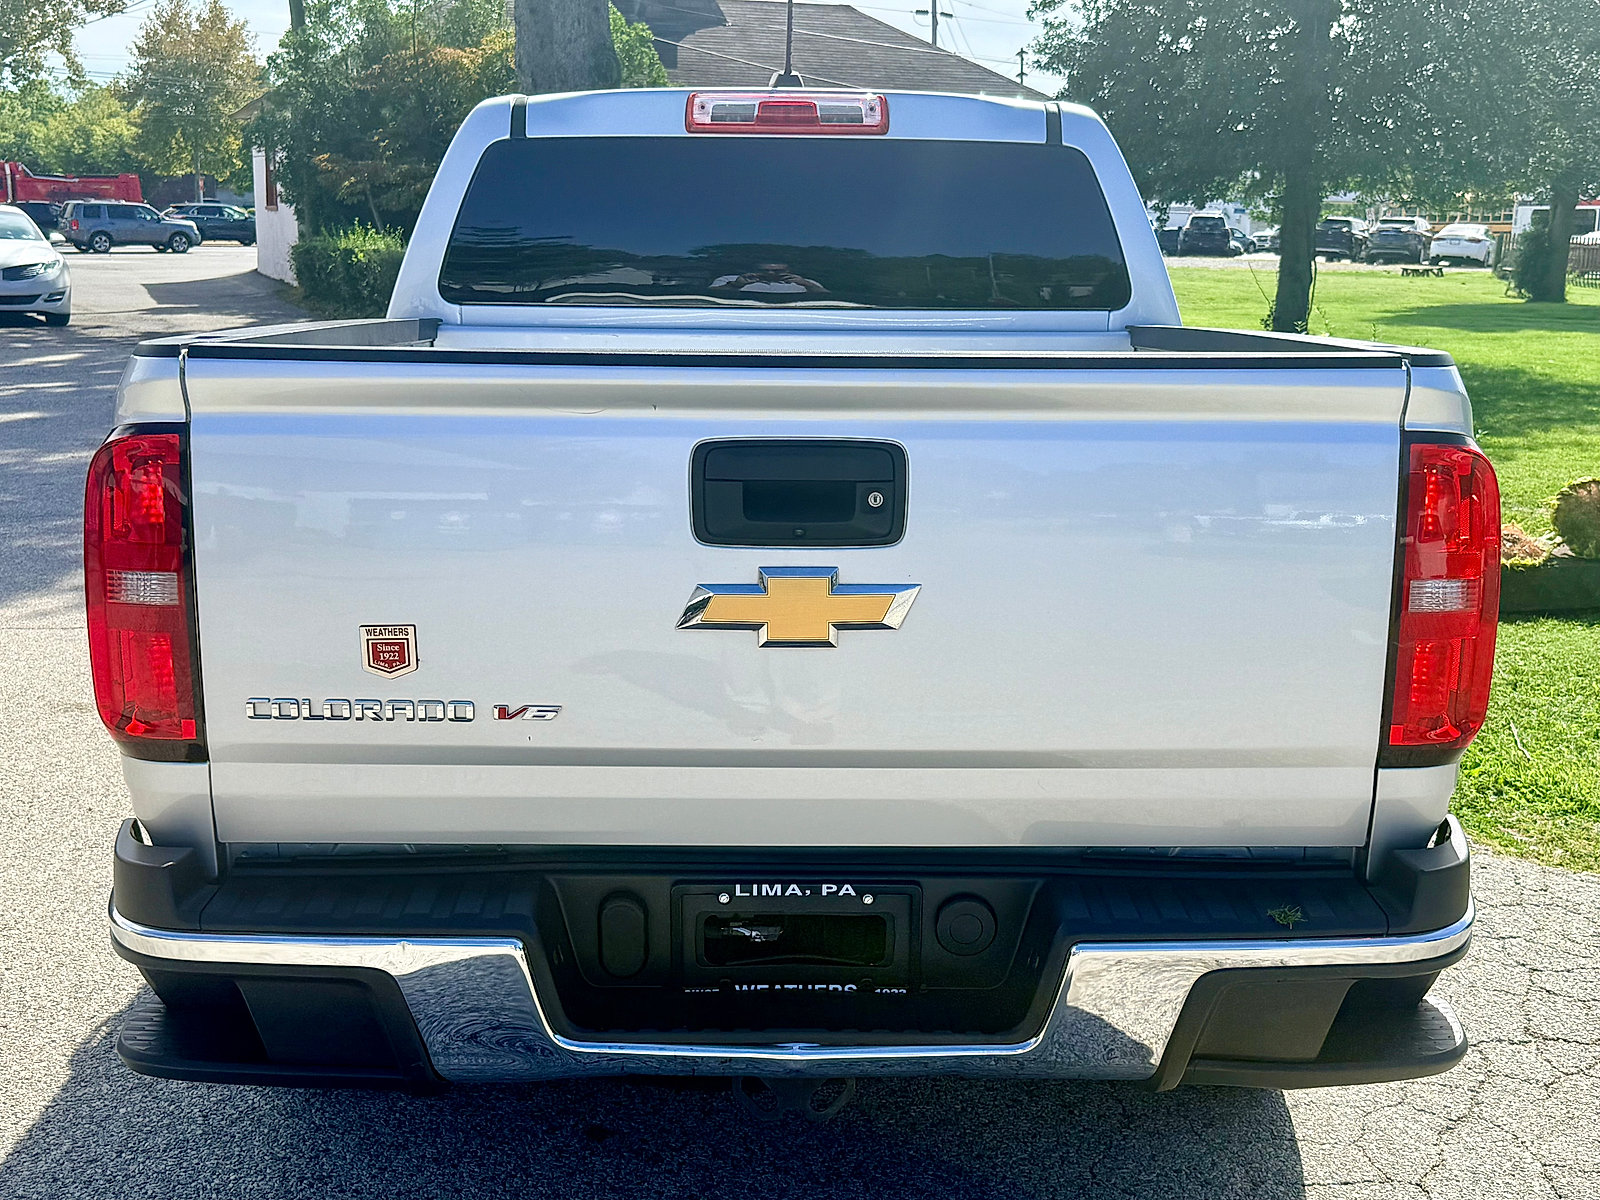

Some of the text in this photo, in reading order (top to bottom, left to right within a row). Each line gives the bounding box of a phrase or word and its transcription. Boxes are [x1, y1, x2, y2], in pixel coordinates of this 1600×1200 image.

[365, 628, 410, 637] WEATHERS
[376, 643, 400, 652] Since
[379, 652, 400, 661] 1922
[245, 697, 562, 722] COLORADO V6
[735, 884, 857, 897] LIMA, PA
